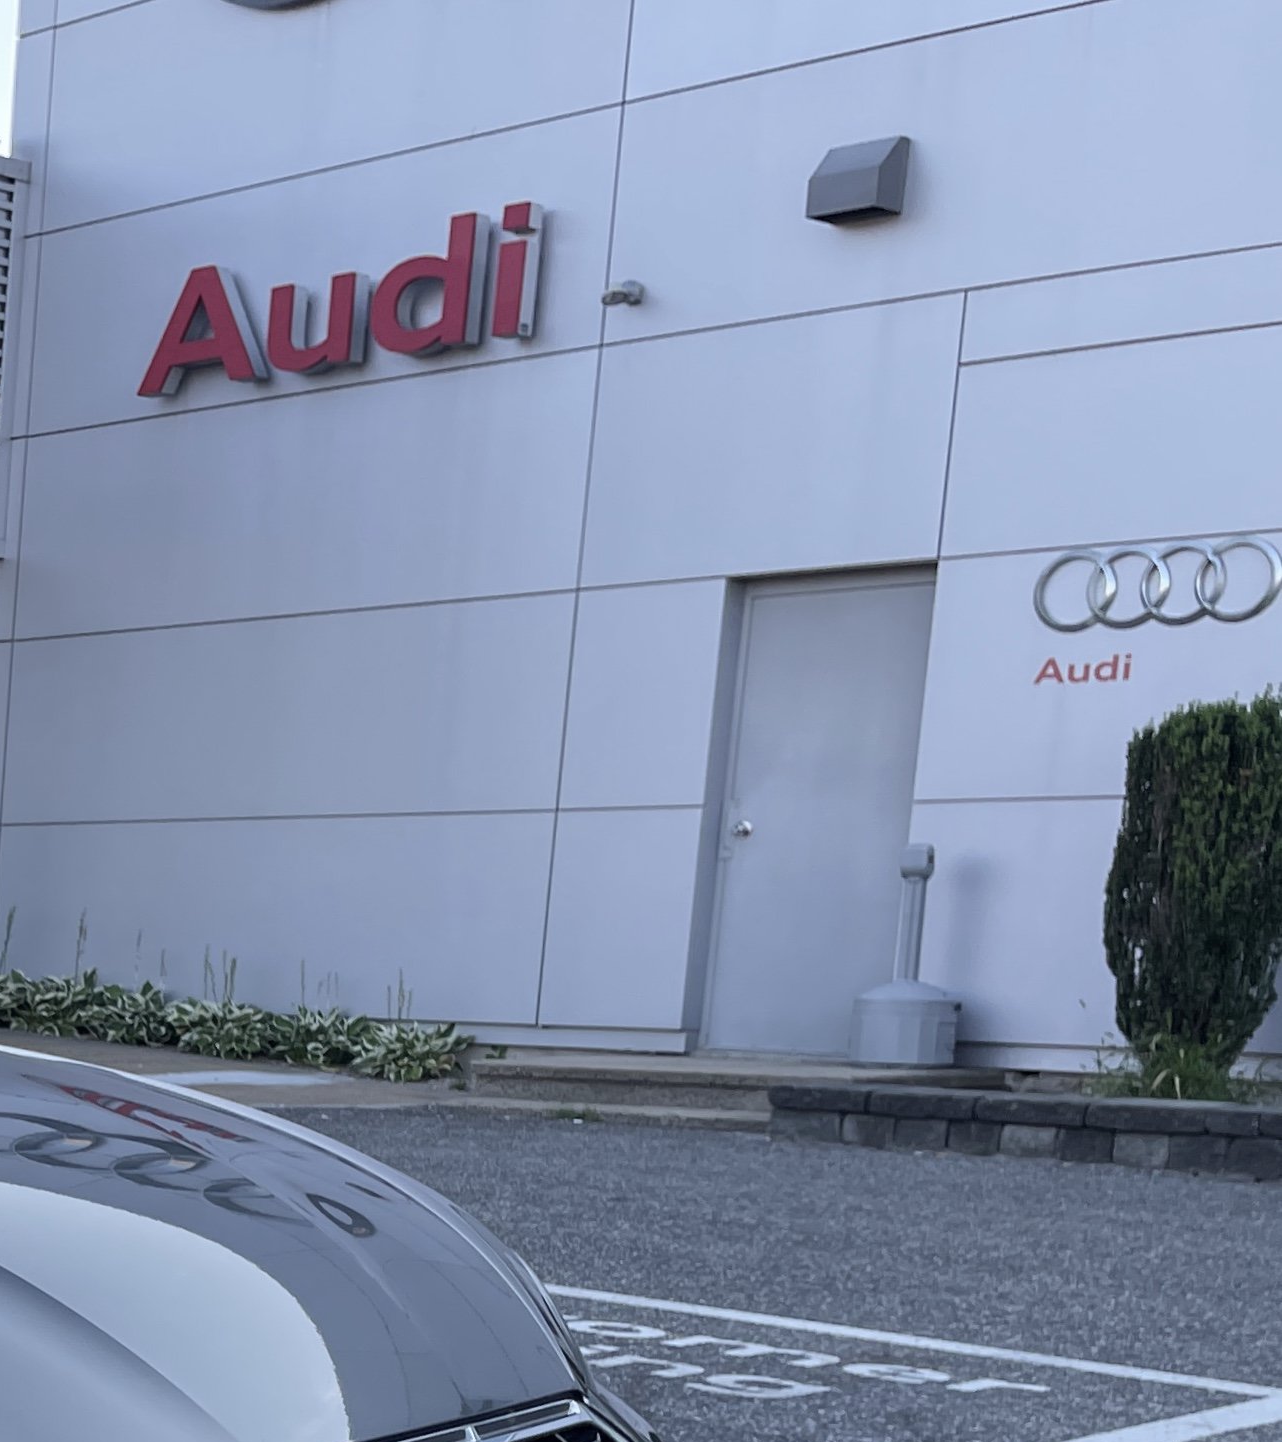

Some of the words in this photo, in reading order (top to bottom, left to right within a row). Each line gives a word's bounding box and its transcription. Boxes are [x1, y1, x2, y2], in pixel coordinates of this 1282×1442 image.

[137, 201, 542, 397] Audi
[1034, 653, 1132, 686] Audi
[563, 1314, 1052, 1394] omer
